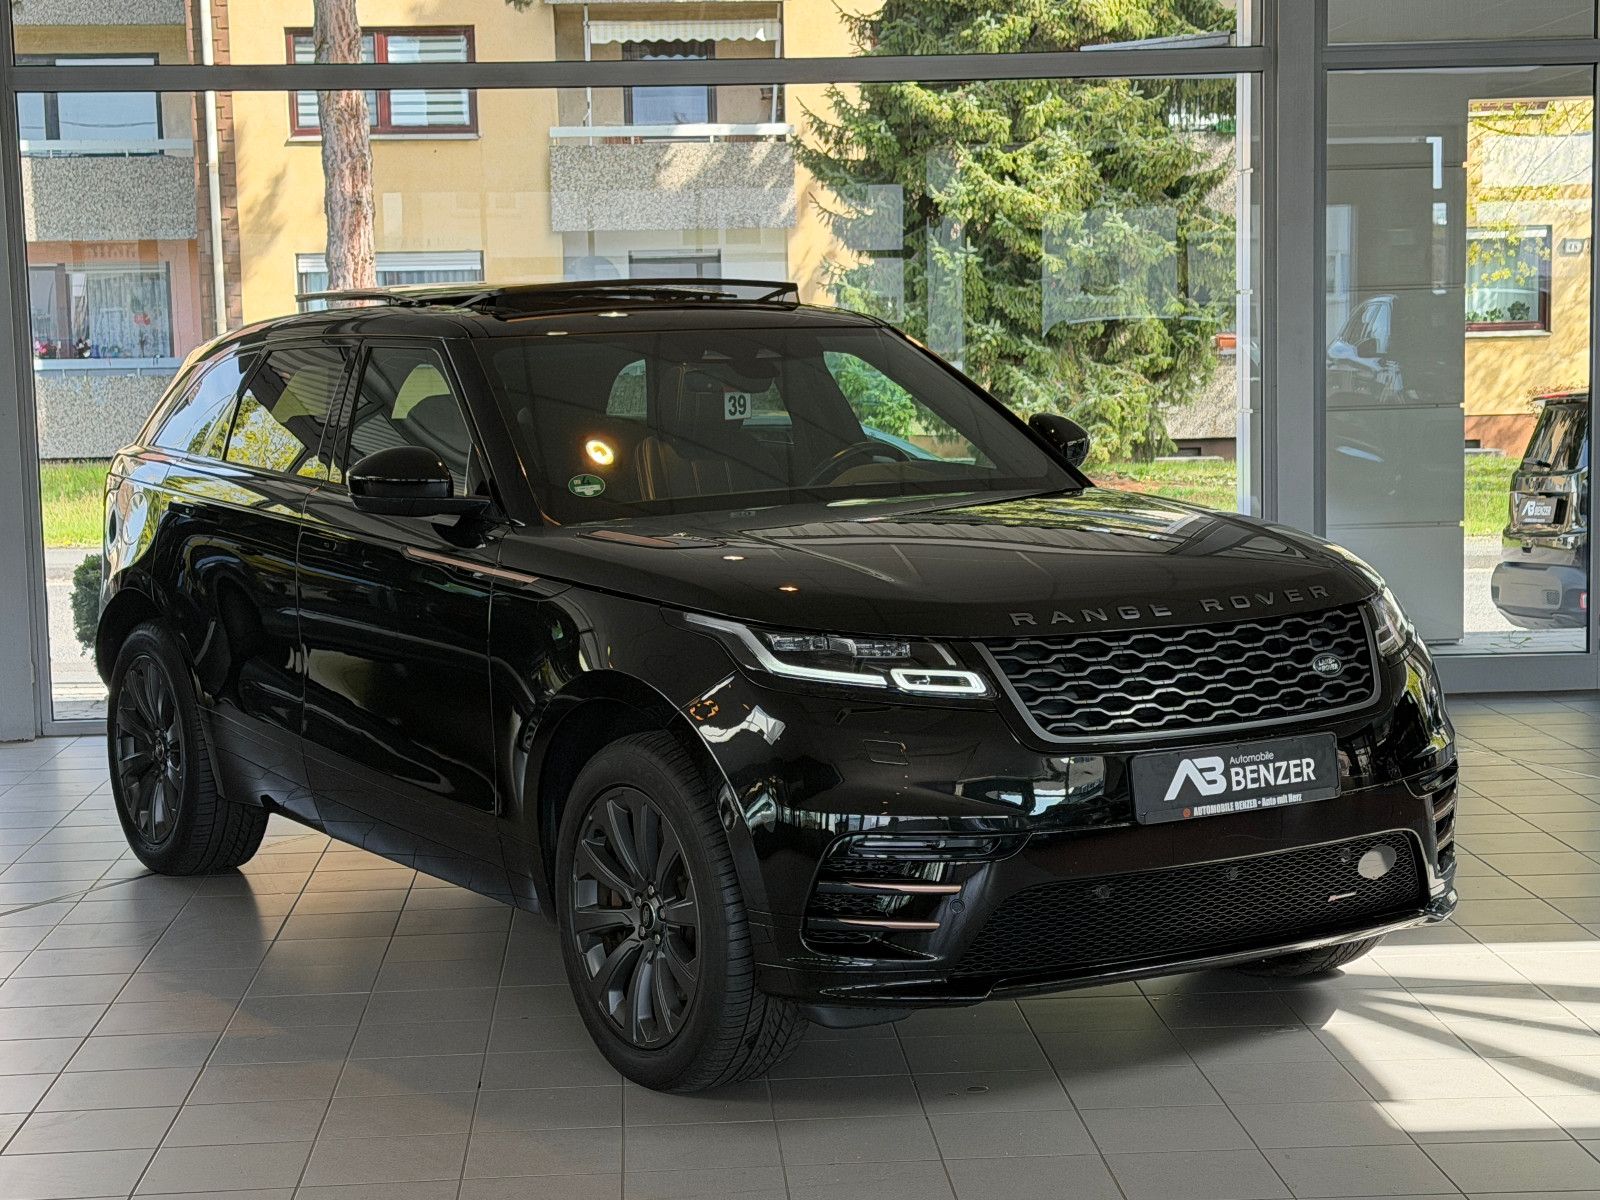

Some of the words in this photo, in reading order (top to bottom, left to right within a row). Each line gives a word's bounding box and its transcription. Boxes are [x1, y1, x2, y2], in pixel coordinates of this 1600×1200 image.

[728, 394, 747, 416] 39
[1008, 604, 1173, 627] RANGE
[1200, 585, 1330, 613] ROVER
[1229, 751, 1275, 766] Automobile
[1230, 758, 1317, 792] BENZER
[1193, 802, 1235, 817] AUTOMOBILE
[1235, 799, 1258, 811] BENZER
[1277, 794, 1288, 805] mit
[1288, 793, 1303, 804] Herz
